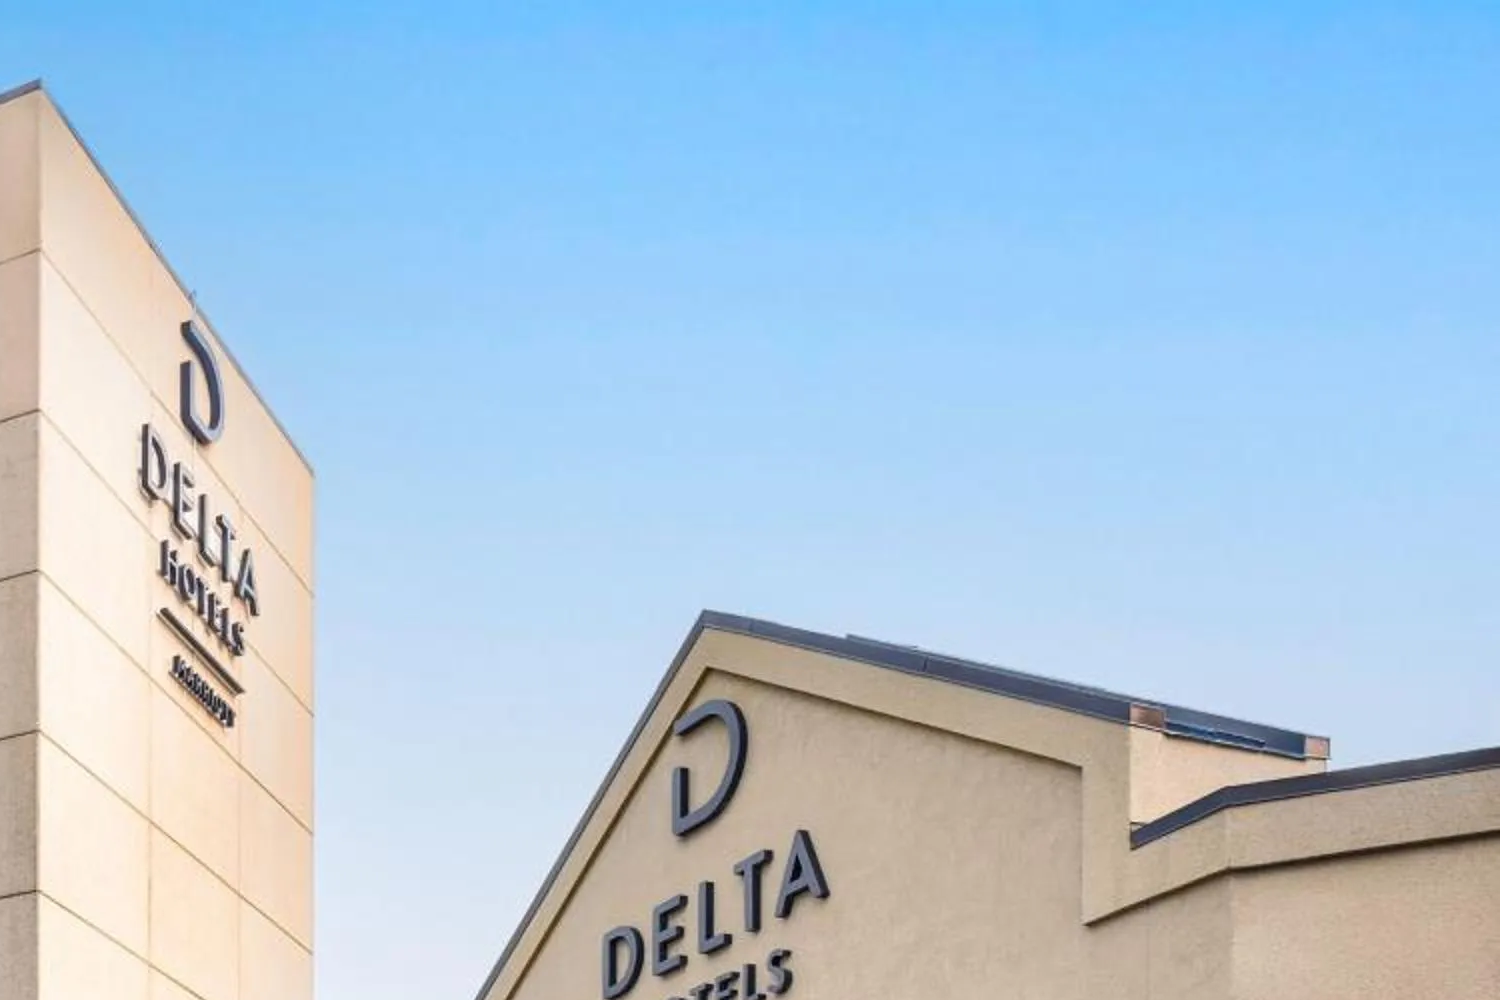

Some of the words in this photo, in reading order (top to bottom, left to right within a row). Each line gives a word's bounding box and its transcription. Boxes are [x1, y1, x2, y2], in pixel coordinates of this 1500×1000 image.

[141, 422, 260, 617] DELTA
[159, 539, 244, 657] HOTELS
[602, 829, 831, 1000] DELTA
